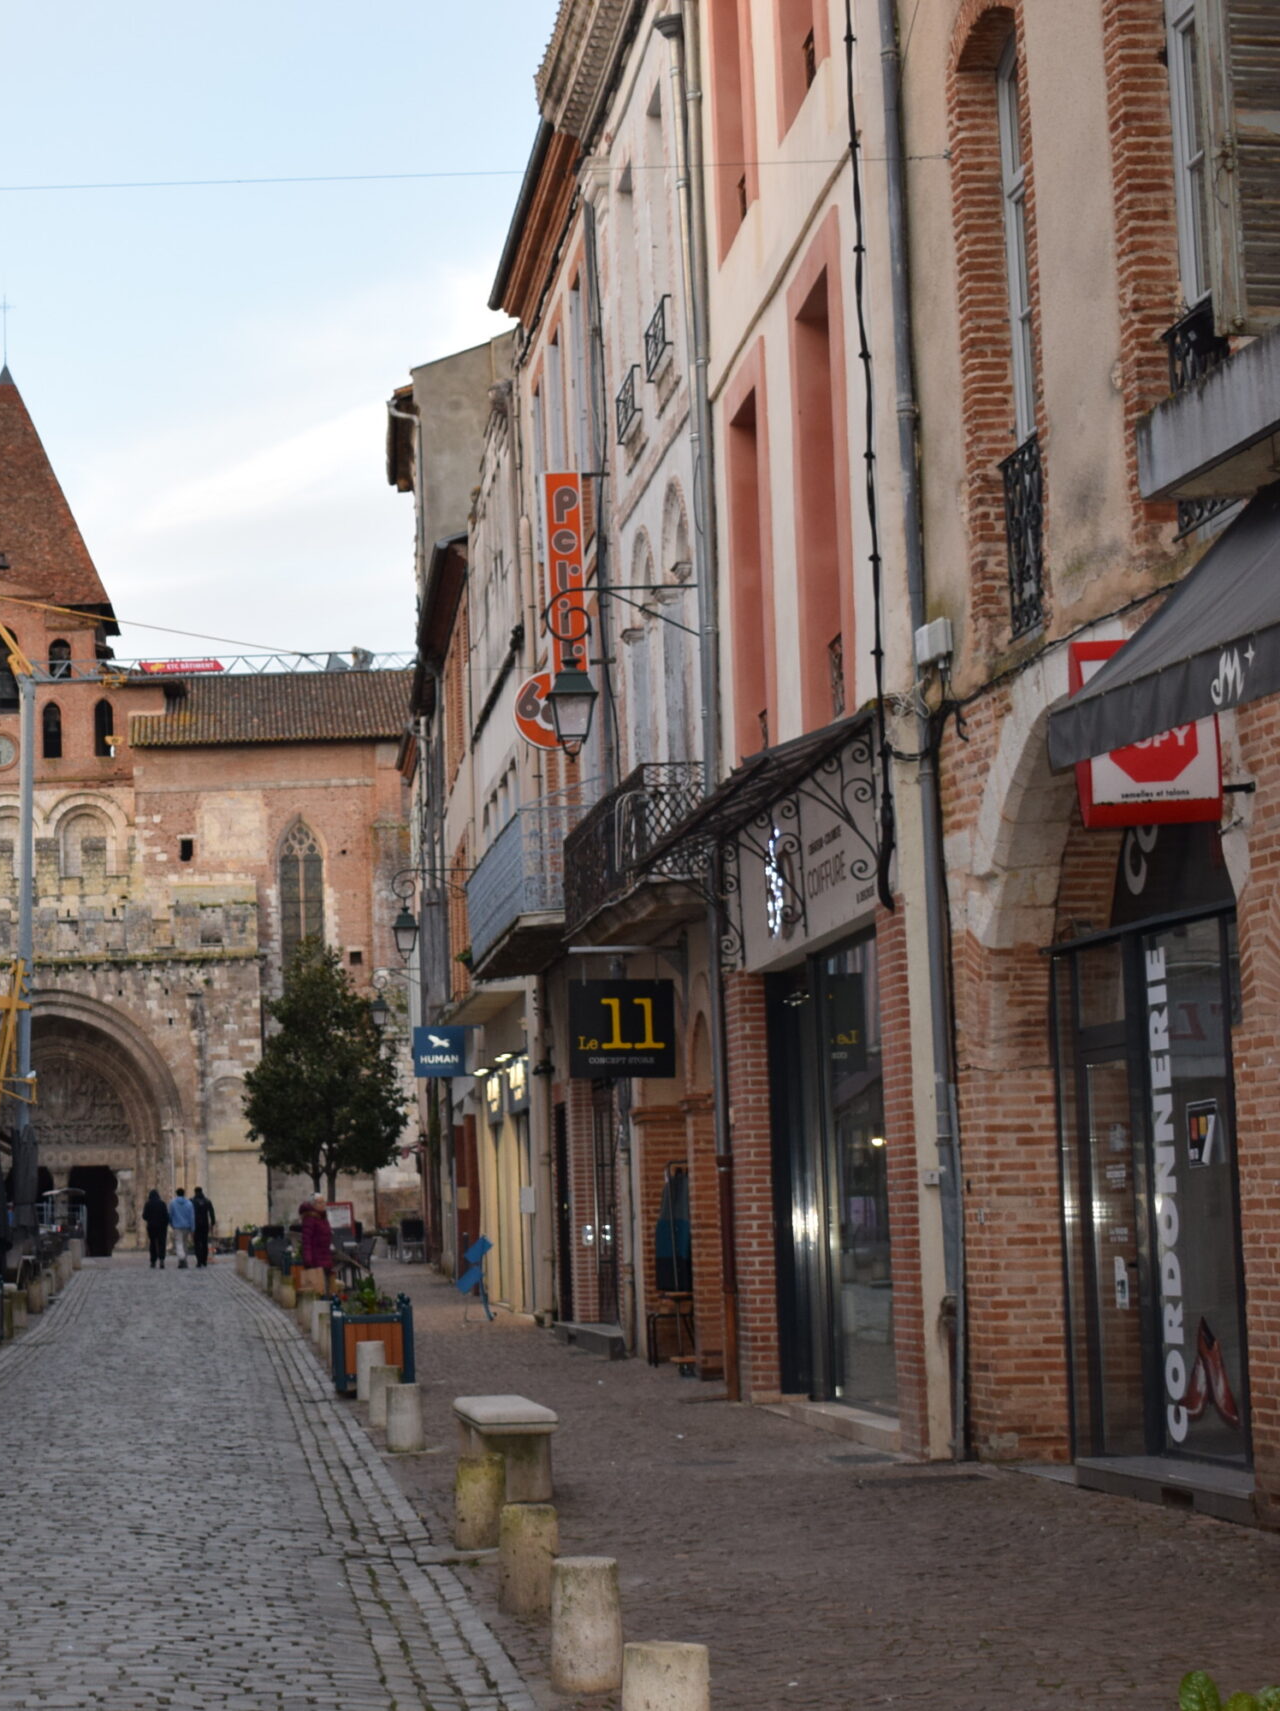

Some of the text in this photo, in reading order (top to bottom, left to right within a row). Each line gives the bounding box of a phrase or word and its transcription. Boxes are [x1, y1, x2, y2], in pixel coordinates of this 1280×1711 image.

[1121, 789, 1153, 799] semelles
[1166, 788, 1190, 797] talons
[807, 849, 847, 900] COIFFURE
[578, 1036, 599, 1050] Le
[420, 1054, 459, 1065] HUMAN
[588, 1056, 626, 1064] CONCEPT
[1145, 945, 1189, 1444] CORDONNERIE
